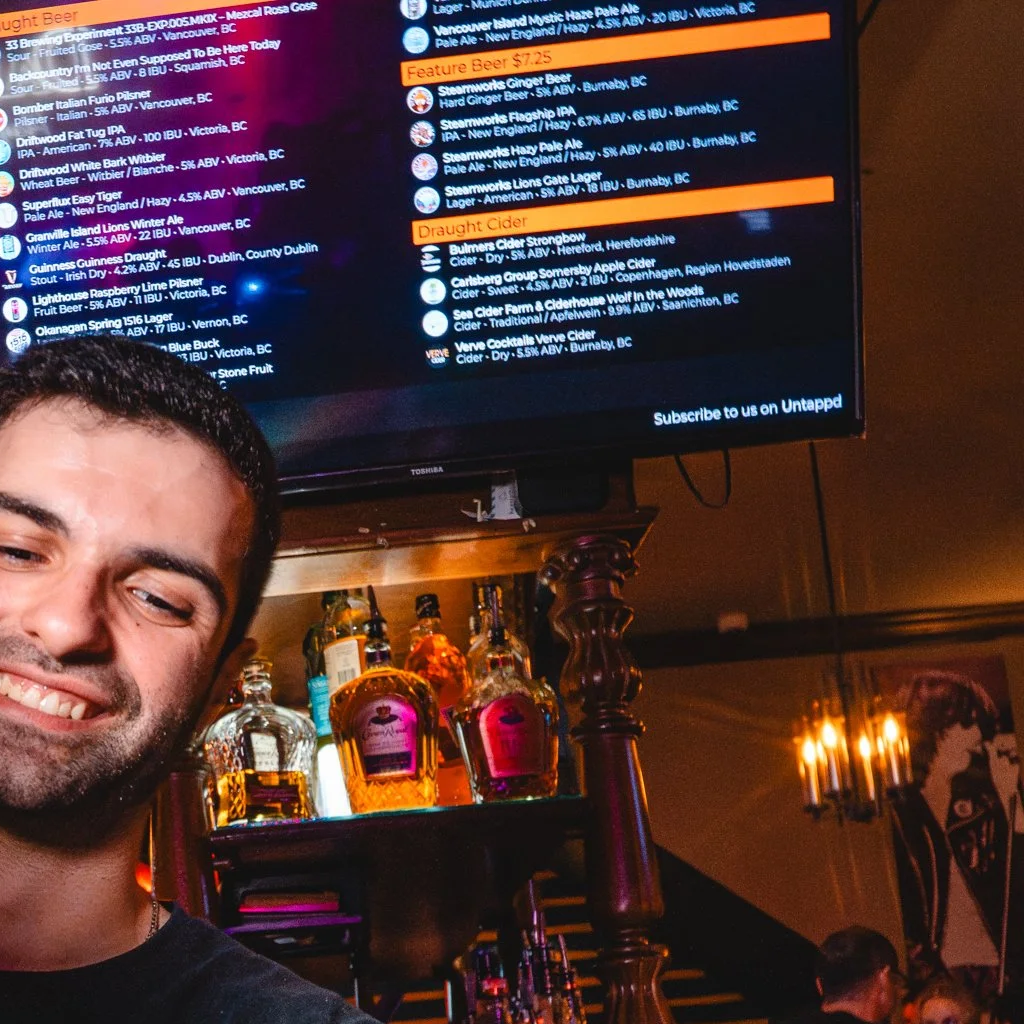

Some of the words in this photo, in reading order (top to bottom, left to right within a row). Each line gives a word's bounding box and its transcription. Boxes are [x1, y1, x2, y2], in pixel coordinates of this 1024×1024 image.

[43, 11, 79, 26] Beer
[433, 4, 463, 15] Lager
[434, 21, 492, 36] Vancouver
[494, 15, 526, 29] Island
[529, 12, 564, 27] Mystic
[566, 10, 593, 21] Haze
[595, 6, 619, 18] Pale
[621, 4, 640, 15] Ale
[5, 38, 18, 49] 33
[20, 34, 63, 47] Brewing
[63, 24, 124, 43] Experiment
[226, 7, 262, 21] Mezcal
[264, 5, 289, 16] Rosa
[291, 2, 318, 13] Gose
[9, 65, 73, 81] Backcountry
[92, 59, 112, 71] Not
[115, 57, 137, 68] Even
[139, 49, 191, 66] Supposed
[193, 47, 205, 58] To
[207, 46, 221, 57] Be
[223, 44, 247, 55] Here
[249, 39, 281, 51] Today
[407, 63, 467, 80] Feature
[472, 59, 507, 73] Beer
[512, 51, 552, 69] $7.25
[438, 79, 505, 96] Steamworks
[507, 77, 543, 90] Ginger
[546, 74, 572, 85] Beer
[13, 101, 54, 115] Bomber
[56, 97, 87, 109] Italian
[89, 93, 114, 105] Furio
[116, 90, 151, 102] Pilsner
[440, 113, 508, 130] Steamworks
[509, 108, 555, 123] Flagship
[557, 105, 576, 117] IPA
[16, 131, 66, 147] Driftwood
[68, 129, 84, 141] Fat
[85, 127, 106, 140] Tug
[108, 124, 125, 136] IPA
[17, 146, 35, 158] IPA
[42, 141, 91, 155] American
[98, 136, 113, 148] 7%
[115, 134, 136, 146] ABV
[144, 131, 161, 143] 100
[163, 128, 182, 140] IBU
[189, 123, 230, 137] Victoria,
[232, 120, 247, 132] BC
[443, 147, 509, 163] Steamworks
[511, 145, 538, 157] Hazy
[540, 141, 563, 153] Pale
[564, 139, 583, 150] Ale
[19, 163, 70, 179] Driftwood
[72, 160, 101, 172] White
[103, 156, 127, 169] Bark
[129, 152, 166, 165] Witbier
[445, 180, 511, 196] Steamworks
[513, 178, 541, 189] Lions
[544, 174, 569, 186] Gate
[571, 172, 602, 184] Lager
[22, 196, 71, 211] Superflux
[72, 193, 96, 205] Easy
[96, 190, 123, 203] Tiger
[25, 228, 69, 242] Granville
[71, 223, 101, 237] Island
[103, 222, 129, 233] Lions
[131, 217, 166, 230] Winter
[167, 214, 184, 226] Ale
[418, 218, 482, 238] Draught
[487, 215, 528, 231] Cider
[450, 254, 477, 266] Cider
[486, 251, 505, 264] Dry
[511, 248, 526, 260] 5%
[527, 246, 549, 258] ABV
[558, 241, 605, 255] Hereford,
[607, 235, 675, 250] Herefordshire
[496, 237, 524, 249] Cider
[526, 232, 586, 246] Strongbow
[29, 260, 75, 273] Guinness
[77, 255, 123, 268] Guinness
[125, 247, 167, 262] Draught
[30, 272, 57, 285] Stout
[66, 268, 86, 281] Irish
[88, 267, 107, 280] Dry
[113, 263, 137, 275] 4.2%
[138, 260, 160, 272] ABV
[167, 258, 180, 269] 45
[182, 255, 201, 267] IBU
[209, 251, 244, 264] Dublin,
[246, 246, 283, 260] County
[284, 242, 318, 255] Dublin
[451, 274, 502, 287] Carlsberg
[504, 271, 538, 282] Group
[539, 264, 592, 278] Somersby
[593, 261, 625, 275] Apple
[627, 258, 656, 270] Cider
[33, 290, 88, 306] Lighthouse
[90, 284, 141, 298] Raspberry
[142, 281, 168, 292] Lime
[170, 277, 203, 289] Pilsner
[34, 303, 57, 316] Fruit
[59, 302, 83, 313] Beer
[89, 298, 104, 309] 5%
[105, 295, 127, 308] ABV
[134, 293, 142, 304] 11
[144, 291, 163, 303] IBU
[169, 286, 210, 300] Victoria,
[212, 283, 227, 295] BC
[453, 308, 473, 319] Sea
[475, 305, 503, 317] Cider
[505, 303, 533, 314] Farm
[545, 297, 605, 310] Ciderhouse
[607, 292, 632, 304] Wolf
[645, 289, 665, 301] the
[666, 286, 704, 299] Woods
[35, 322, 86, 336] Okanagan
[88, 318, 122, 332] Spring
[123, 314, 142, 326] 1516
[145, 313, 173, 325] Lager
[169, 340, 192, 351] Blue
[194, 337, 219, 349] Buck
[455, 340, 485, 351] Verve
[487, 334, 535, 348] Cocktails
[536, 333, 565, 344] Verve
[567, 329, 596, 341] Cider
[218, 367, 247, 379] Stone
[249, 362, 273, 375] Fruit
[654, 408, 721, 425] Subscribe
[724, 406, 738, 419] to
[742, 406, 757, 417] us
[761, 404, 778, 415] on
[782, 395, 842, 413] Untappd
[410, 466, 444, 476] TOSHIBA
